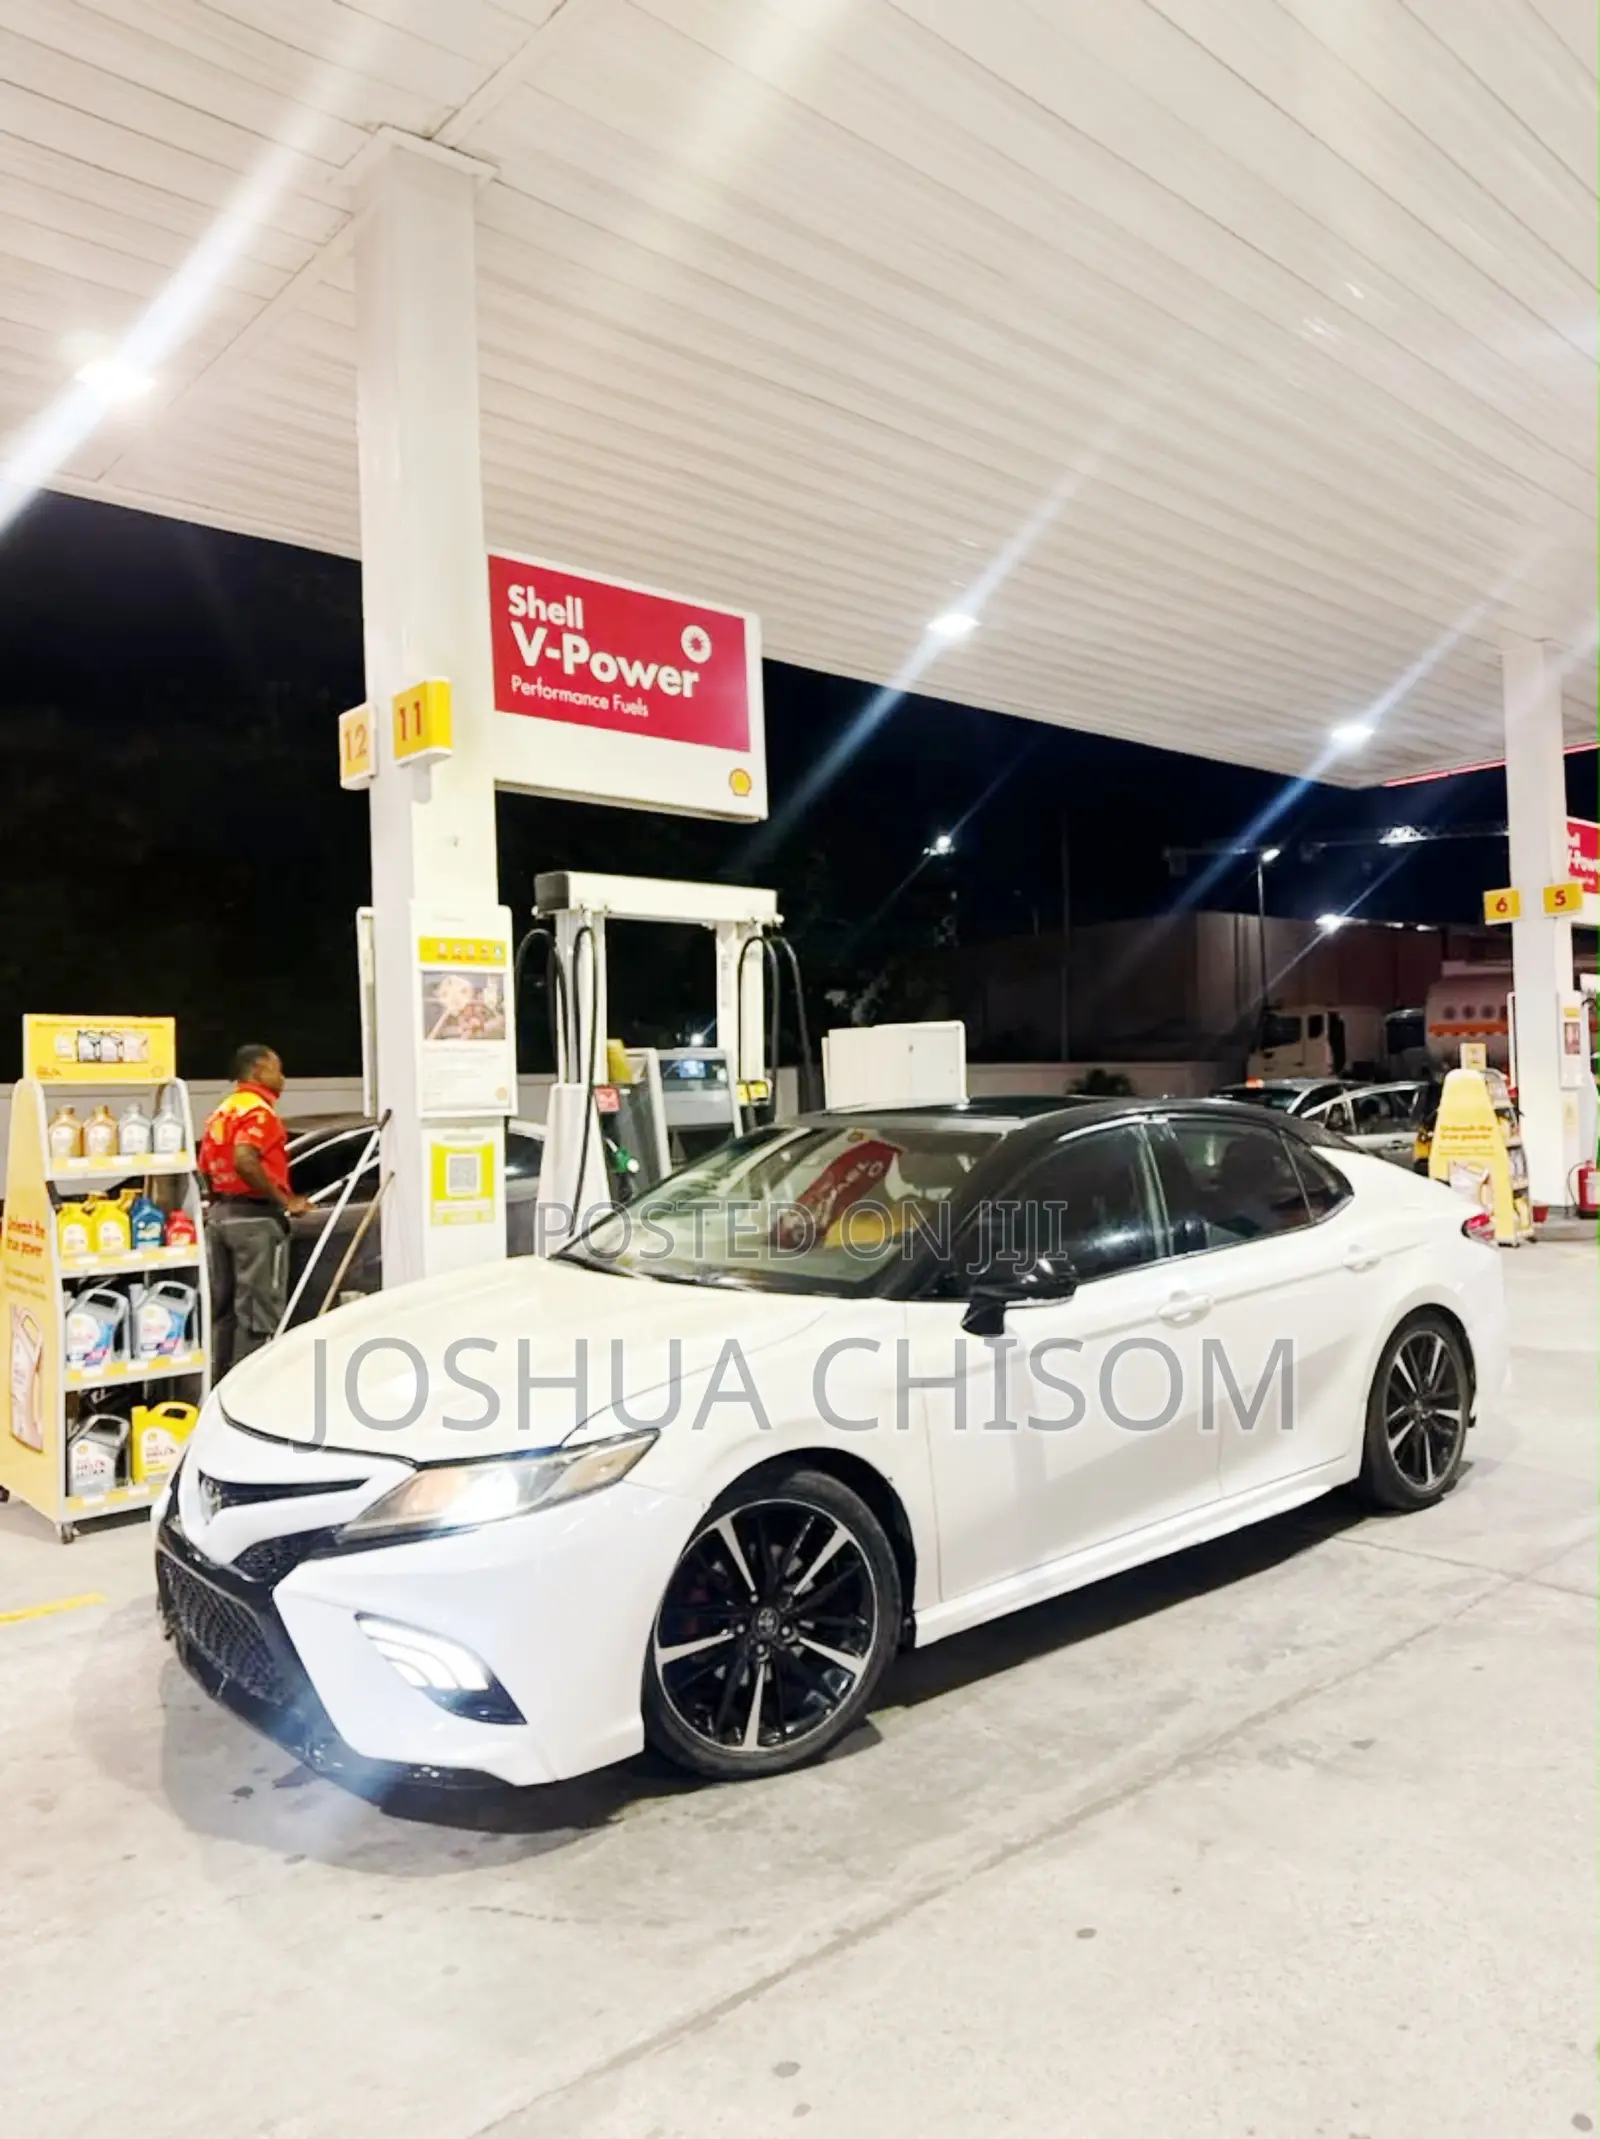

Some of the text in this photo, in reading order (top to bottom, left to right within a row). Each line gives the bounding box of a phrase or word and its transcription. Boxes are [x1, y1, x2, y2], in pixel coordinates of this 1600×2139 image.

[508, 584, 584, 629] Shell
[510, 620, 699, 698] V-Power
[511, 675, 649, 717] Performance Fuels
[399, 700, 422, 742] 11
[344, 723, 367, 762] 12
[1495, 897, 1508, 913] 6
[1554, 890, 1566, 906] 5
